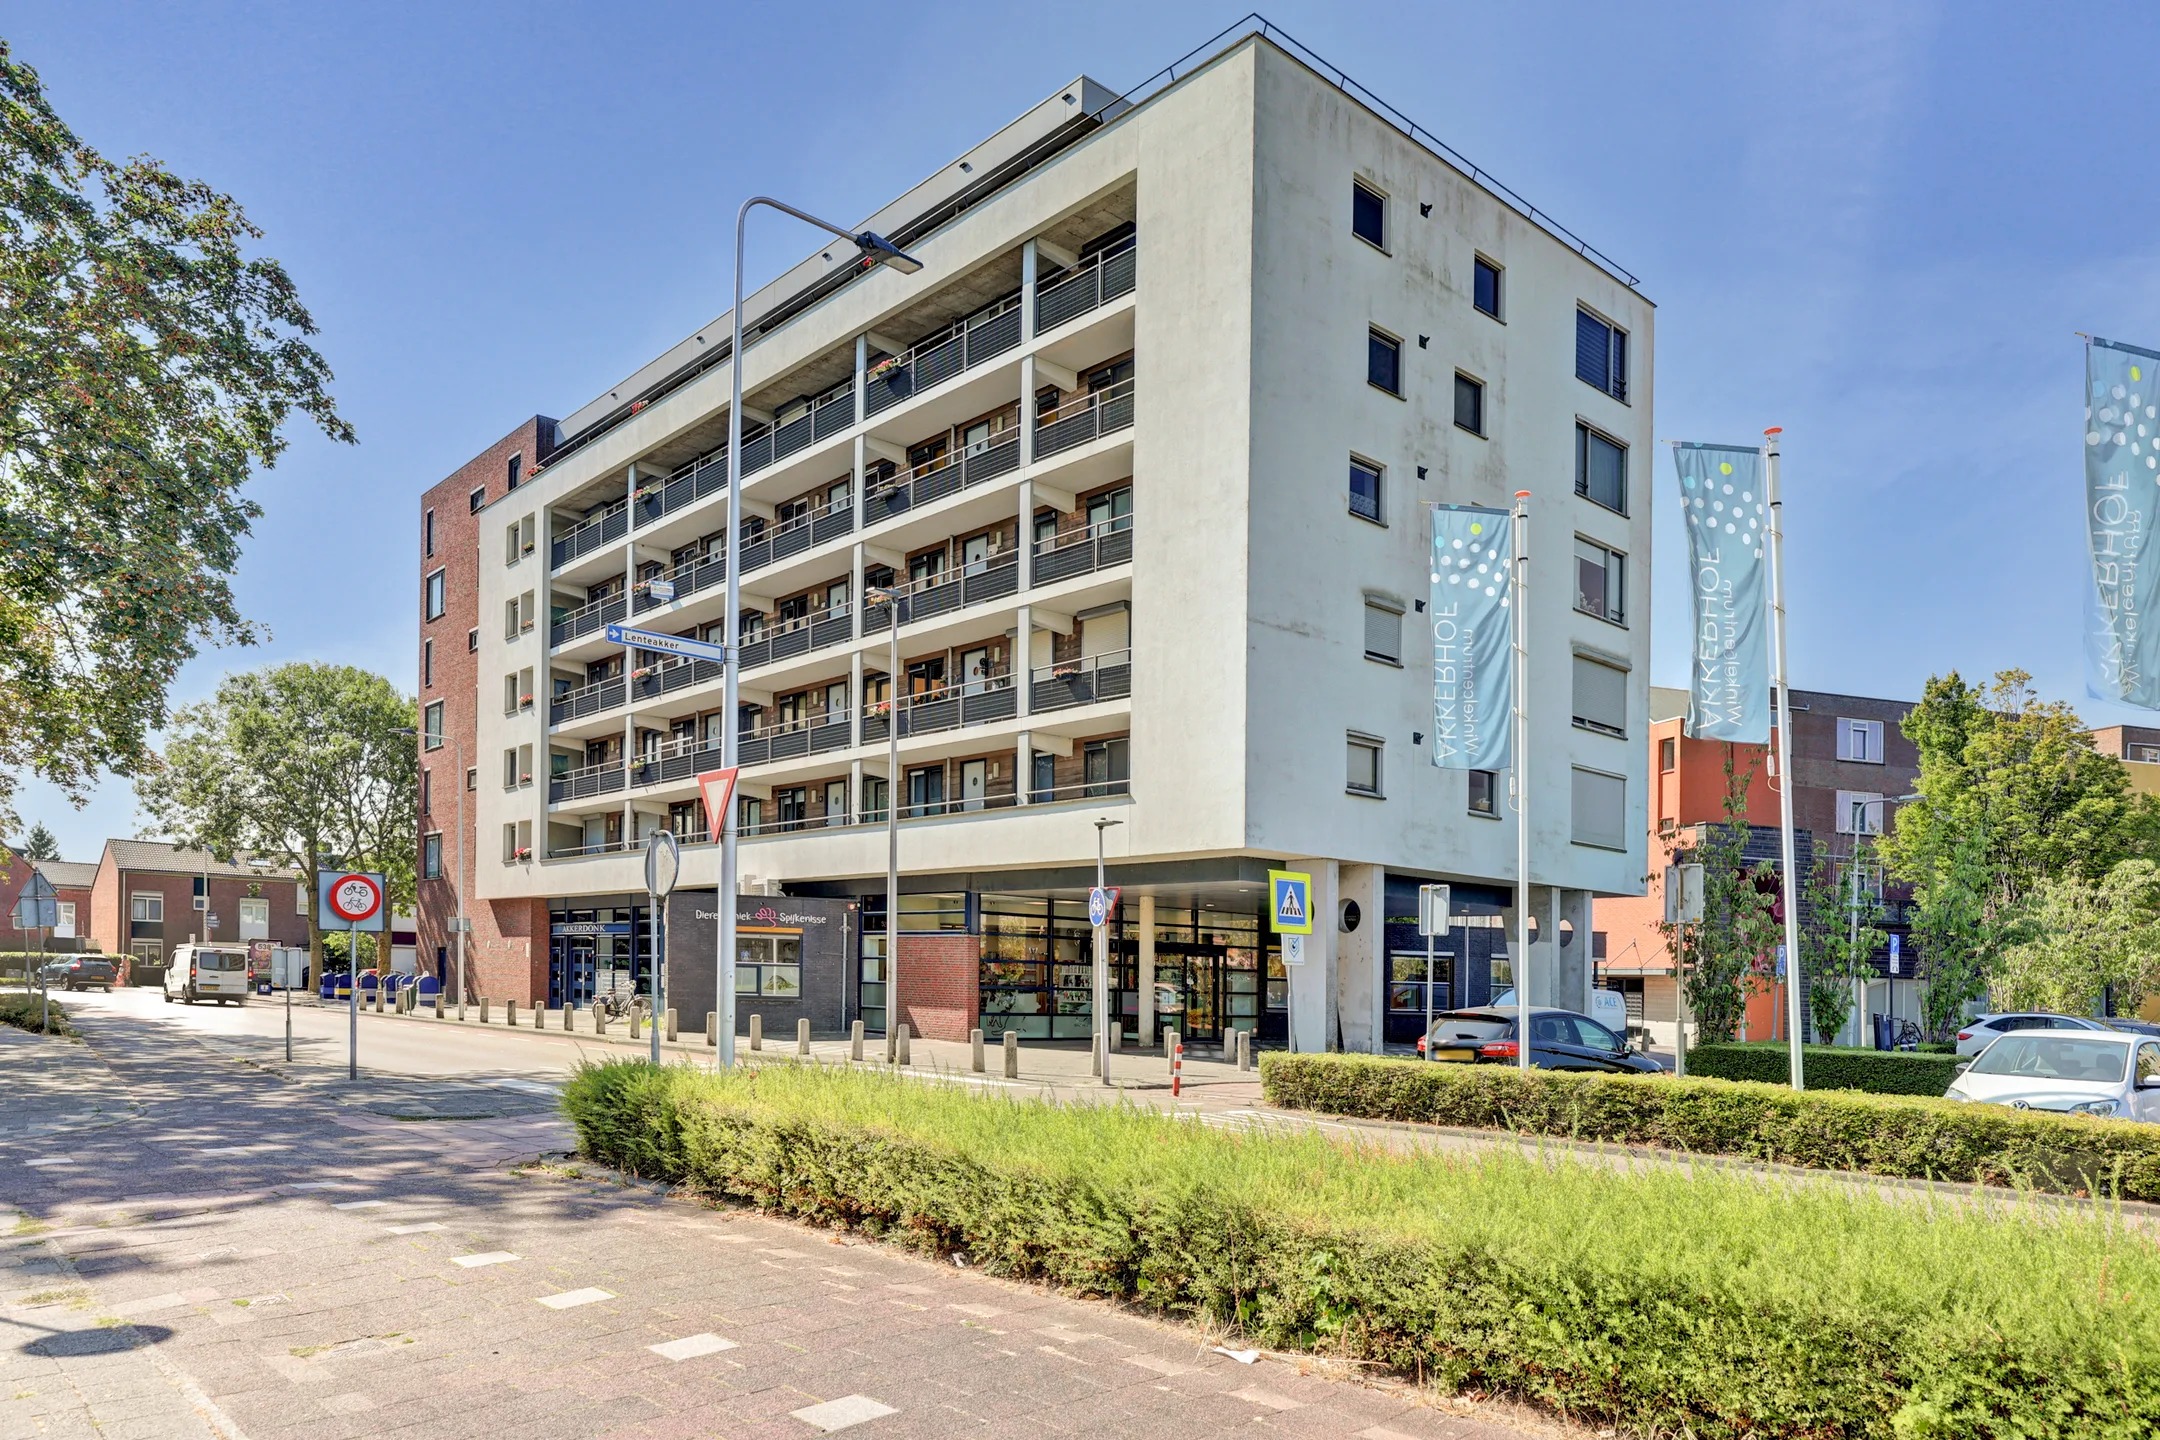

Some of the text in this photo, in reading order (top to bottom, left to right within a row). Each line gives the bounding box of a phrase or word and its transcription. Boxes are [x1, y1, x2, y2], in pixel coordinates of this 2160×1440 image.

[624, 632, 680, 650] Lenteakker
[695, 909, 827, 924] Diereniek Spijkenisse
[562, 924, 606, 933] AKKERDONK
